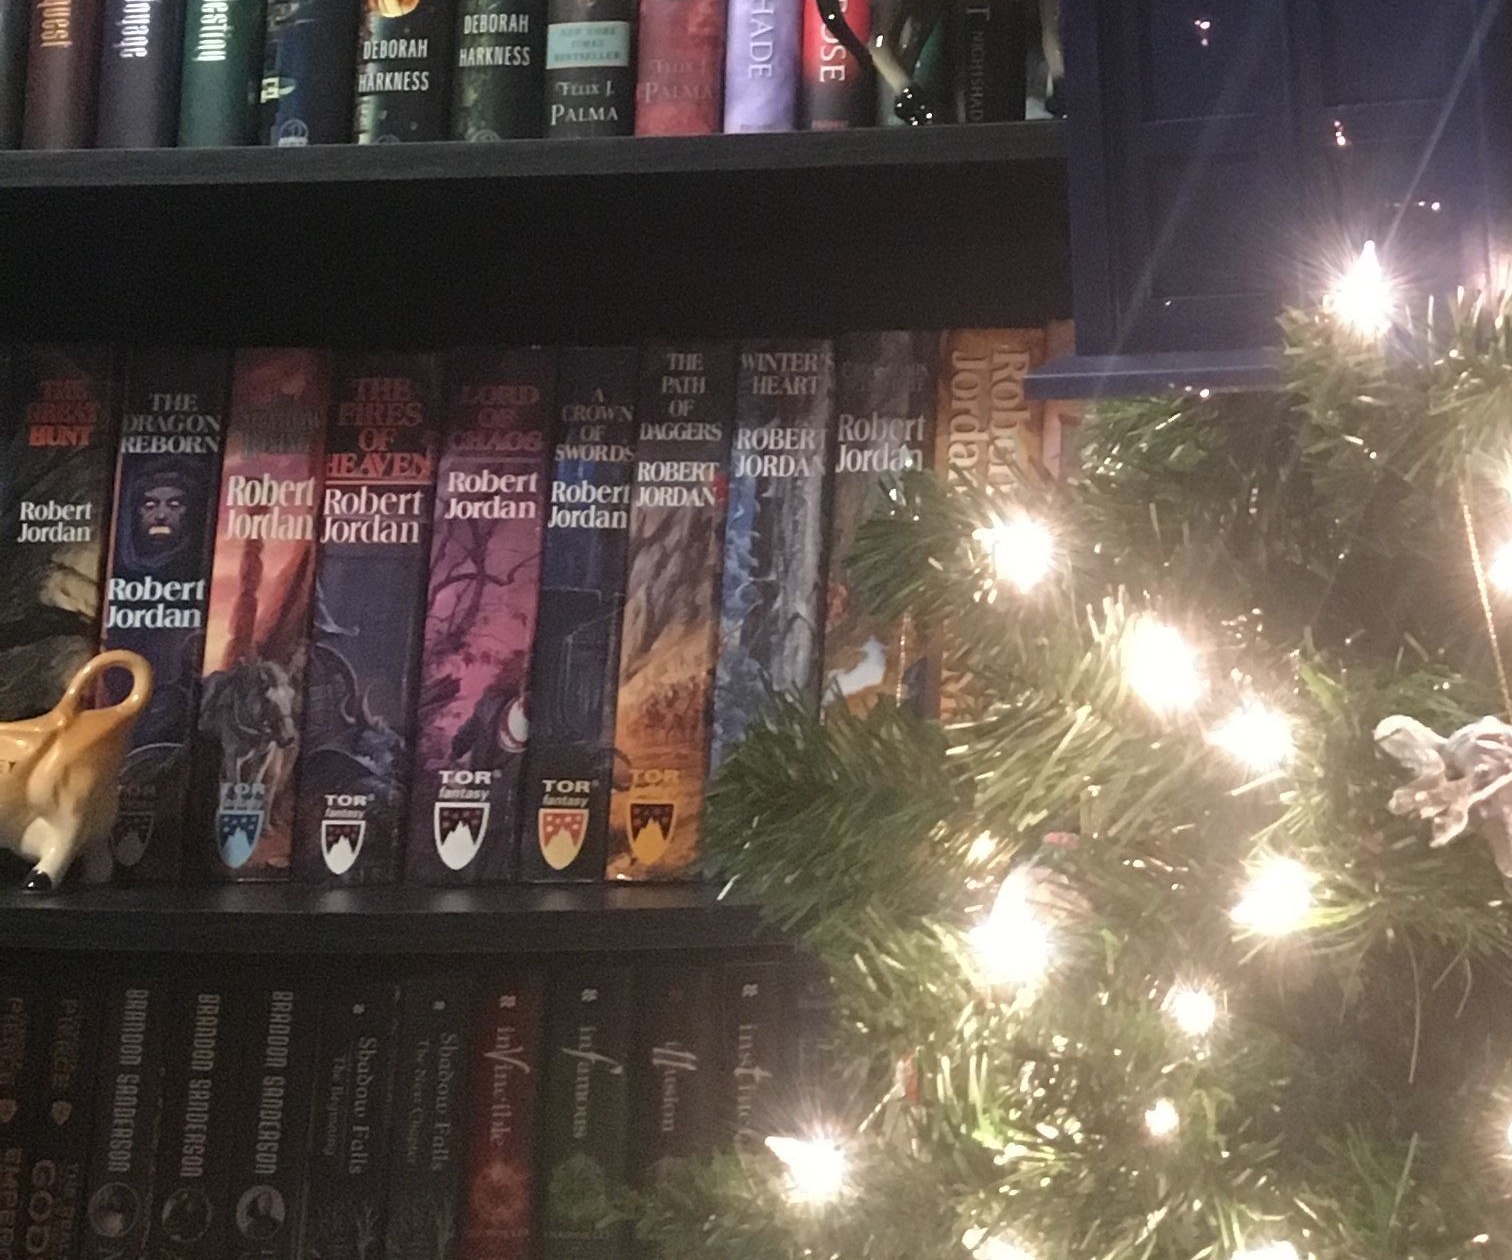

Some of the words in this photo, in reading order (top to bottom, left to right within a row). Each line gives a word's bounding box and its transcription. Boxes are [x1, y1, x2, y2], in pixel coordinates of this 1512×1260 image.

[464, 13, 530, 35] DEBORAH
[363, 39, 429, 60] DEBORAH
[459, 46, 531, 67] HARKNESS
[358, 71, 430, 92] HARKNESS
[550, 103, 620, 126] PALMA
[667, 353, 703, 371] THE
[741, 352, 834, 373] WINTER'S
[591, 387, 604, 402] A
[661, 376, 705, 395] PATH
[752, 376, 819, 395] HEART
[150, 393, 199, 412] THE
[562, 404, 635, 422] CROWN
[668, 399, 695, 418] OF
[122, 414, 222, 433] DRAGON
[580, 425, 607, 442] OF
[640, 423, 723, 441] DAGGERS
[838, 411, 925, 442] Robert
[120, 436, 222, 454] REBORN
[358, 427, 398, 452] OF
[737, 427, 828, 450] ROBERT
[554, 444, 635, 462] SWORDS
[836, 444, 923, 472] Jordan
[326, 452, 432, 478] HEAVEN
[637, 461, 721, 482] ROBERT
[226, 473, 316, 507] Robert
[447, 469, 539, 492] Robert
[551, 480, 631, 503] Robert
[323, 486, 423, 515] Robert
[445, 495, 536, 519] Jordan
[636, 486, 716, 507] JORDAN
[19, 500, 93, 522] Robert
[548, 505, 627, 529] Jordan
[17, 522, 91, 543] Jordan
[225, 507, 313, 540] Jordan
[320, 515, 419, 544] Jordan
[108, 576, 206, 602] Robert
[106, 604, 202, 628] Jordan
[439, 770, 492, 785] TOR
[542, 779, 590, 793] TOR
[630, 769, 680, 784] TOR
[324, 794, 366, 807] TOR
[439, 787, 489, 801] fantasy
[542, 794, 589, 807] fantasy
[120, 989, 150, 1066] BRANDON
[192, 993, 221, 1072] BRANDON
[264, 991, 294, 1068] BRANDON
[352, 1036, 378, 1118] Shadow
[434, 1031, 459, 1115] Shadow
[107, 1074, 141, 1172] SANDERSON
[180, 1079, 213, 1177] SANDERSON
[254, 1076, 287, 1174] SANDERSON
[348, 1124, 371, 1175] Falls
[431, 1121, 453, 1171] Falls
